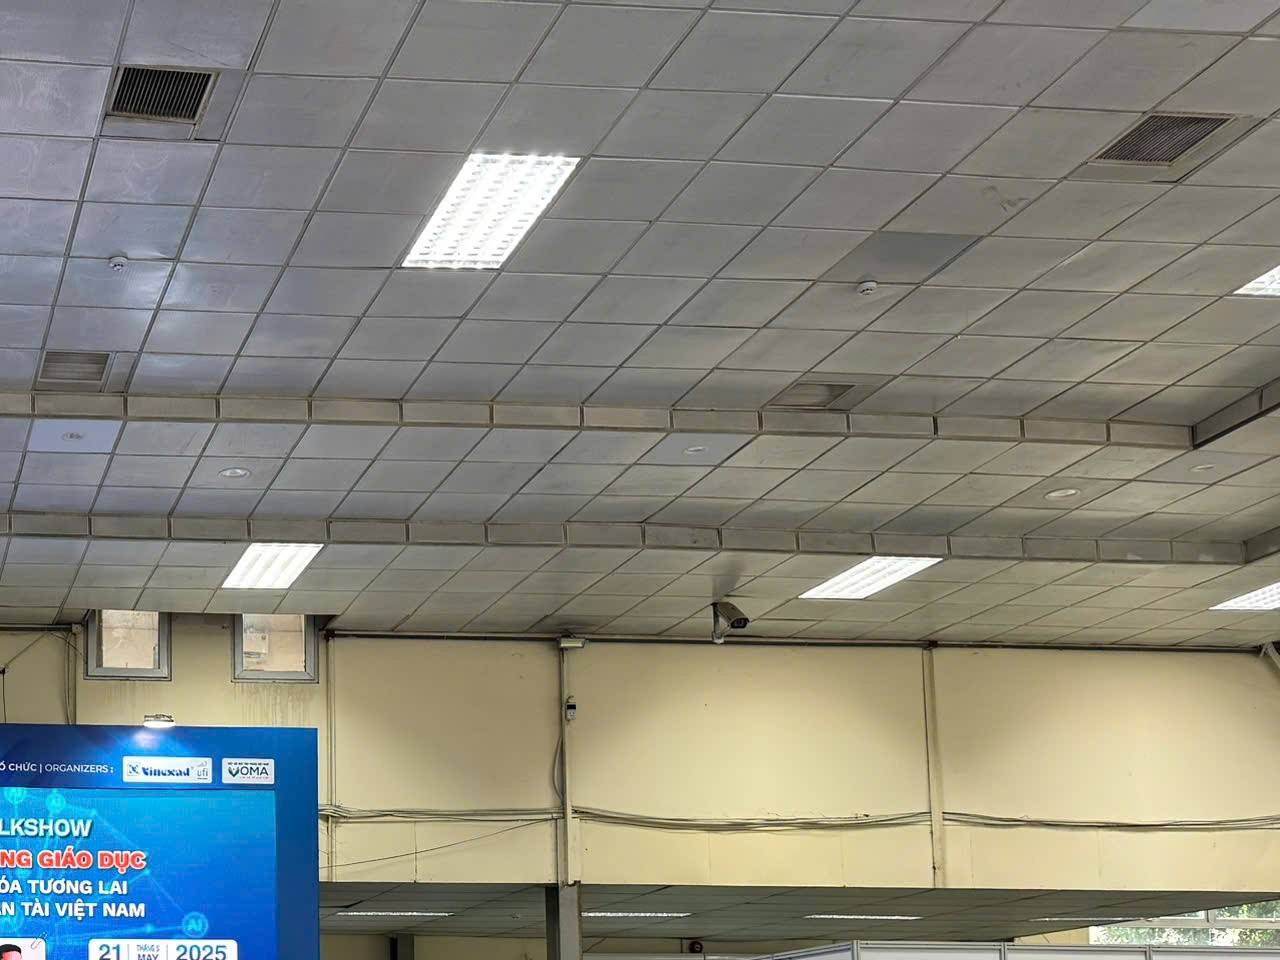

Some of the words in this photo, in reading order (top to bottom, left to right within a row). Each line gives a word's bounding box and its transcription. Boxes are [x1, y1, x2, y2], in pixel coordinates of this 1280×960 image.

[8, 762, 37, 772] CHỨC
[37, 846, 92, 869] GIÁO
[98, 850, 146, 874] DỤC
[27, 879, 92, 894] TƯƠNG
[98, 880, 127, 894] LAI
[21, 898, 50, 917] TÀI
[55, 899, 97, 920] VIỆT
[103, 903, 145, 917] NAM
[99, 944, 120, 960] 21
